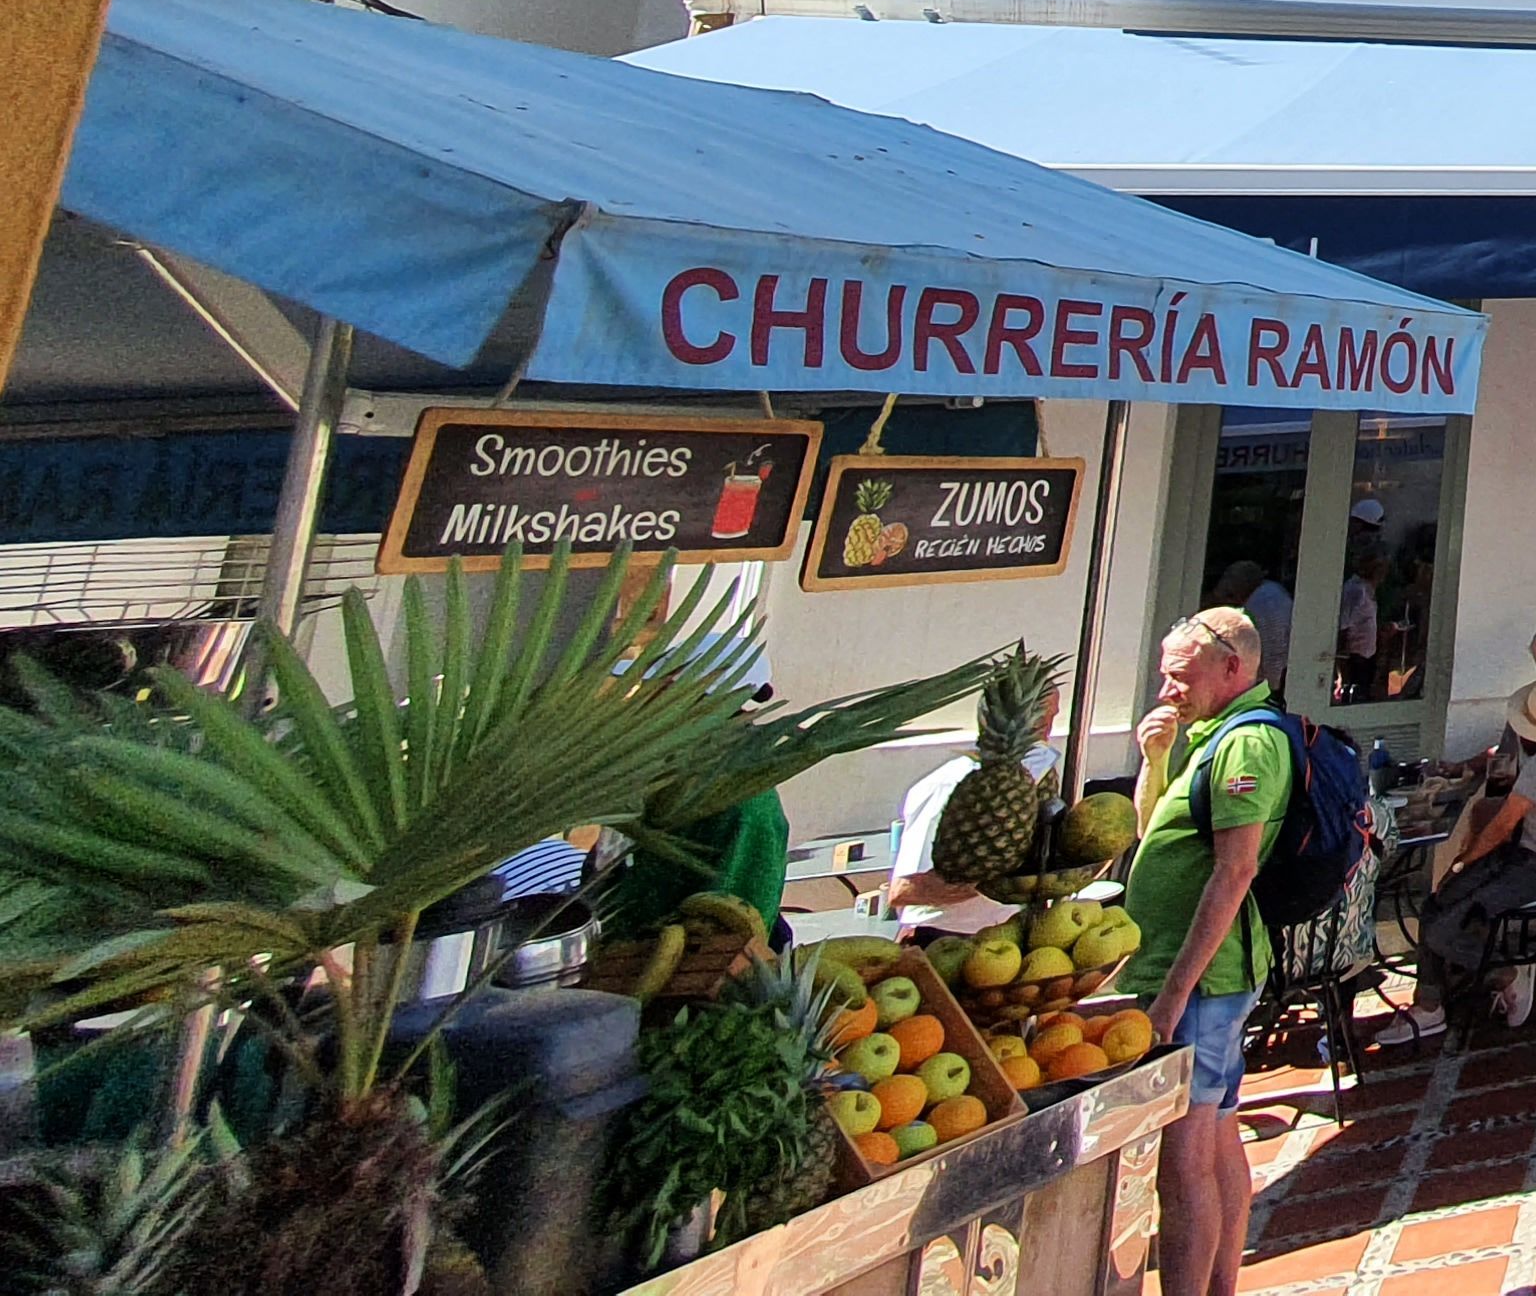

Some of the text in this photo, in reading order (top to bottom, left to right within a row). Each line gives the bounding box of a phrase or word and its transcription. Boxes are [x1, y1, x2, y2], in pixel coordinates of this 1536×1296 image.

[660, 266, 1455, 396] CHURRERÍA RAMÓN
[469, 433, 692, 478] Smoothies
[439, 503, 681, 545] Milkshakes
[930, 479, 1050, 527] ZUMOS
